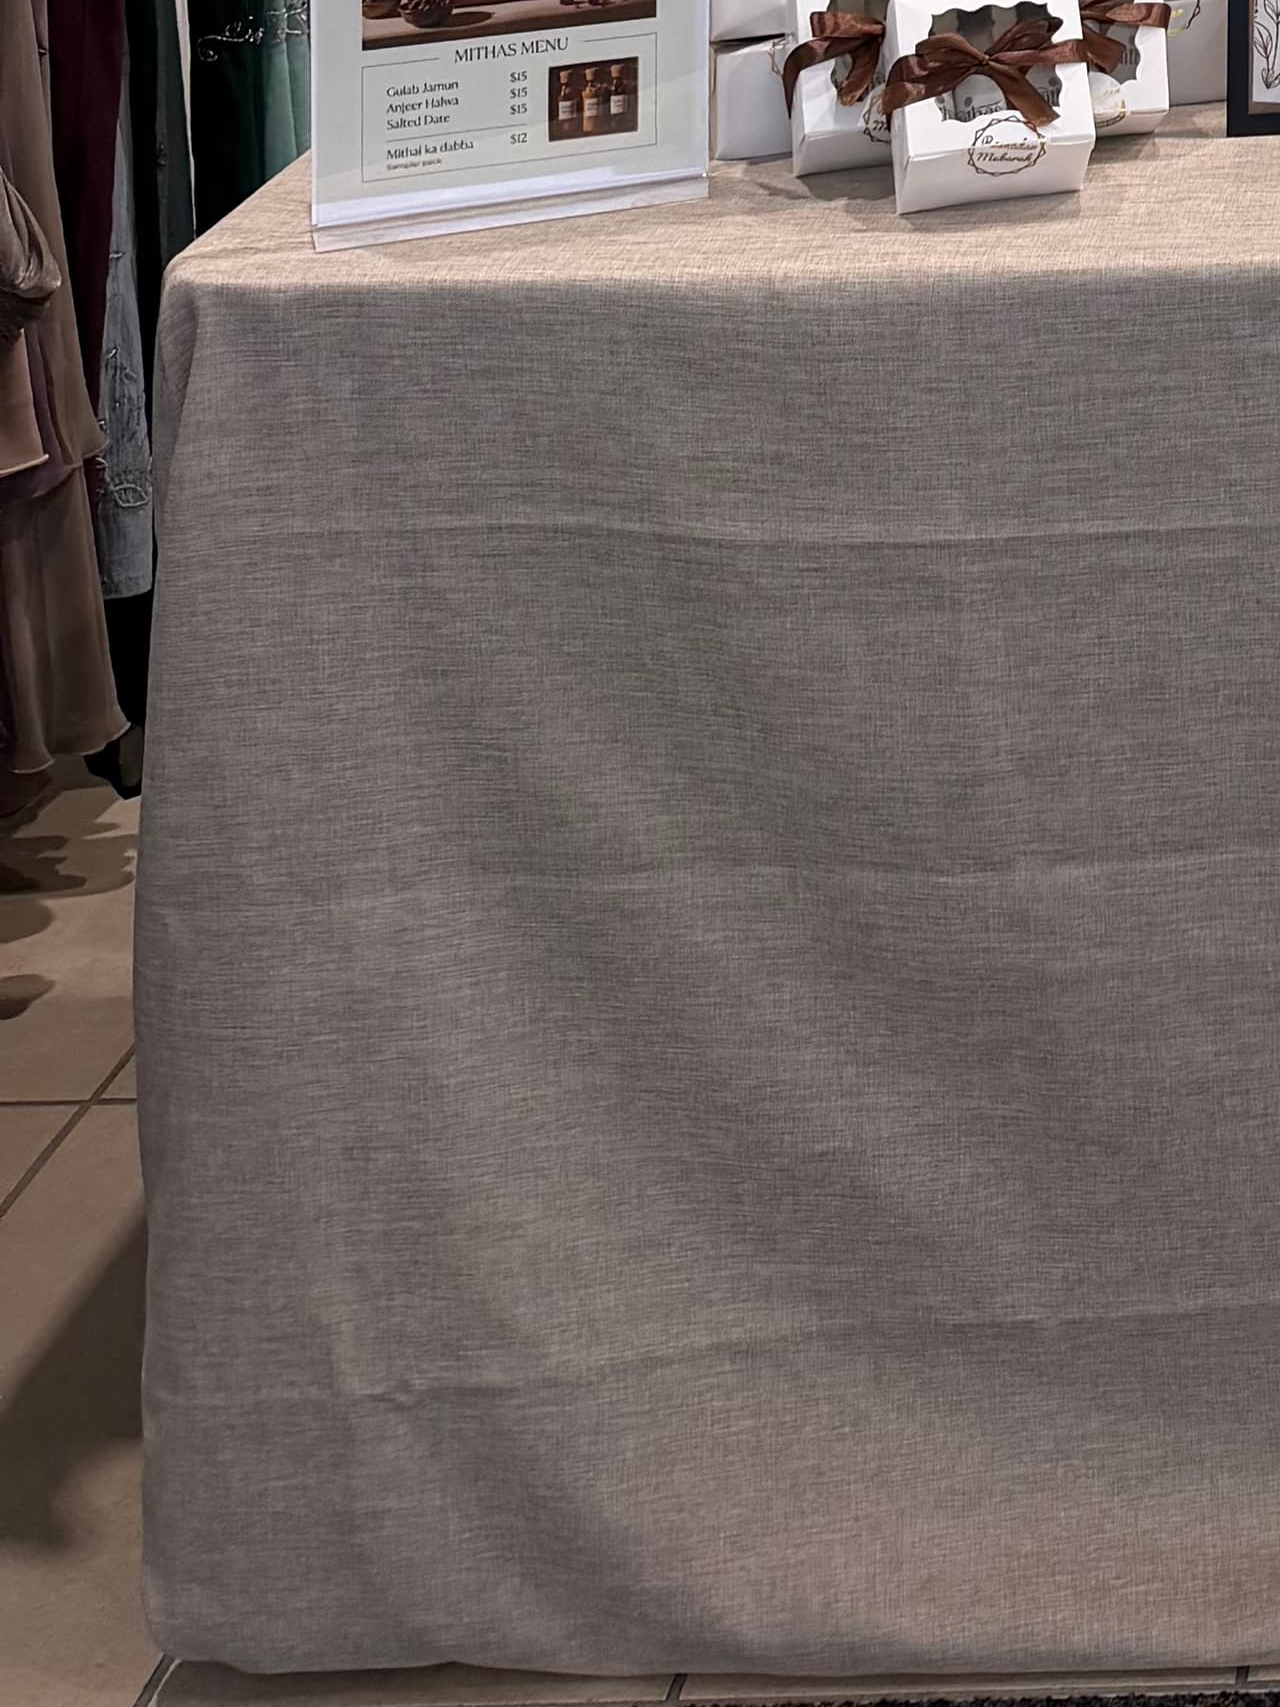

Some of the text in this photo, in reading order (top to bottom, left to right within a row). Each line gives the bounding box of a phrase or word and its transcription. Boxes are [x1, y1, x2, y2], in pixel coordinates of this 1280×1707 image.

[453, 36, 570, 64] MITHAS MENU
[509, 70, 528, 83] $15
[386, 80, 459, 98] Gulab Jamun
[509, 86, 528, 99] $15
[386, 100, 422, 115] Anjeer
[509, 102, 528, 116] $15
[386, 114, 451, 131] Salted Date
[509, 132, 528, 145] $12
[424, 143, 438, 155] ka
[439, 139, 474, 153] dabba
